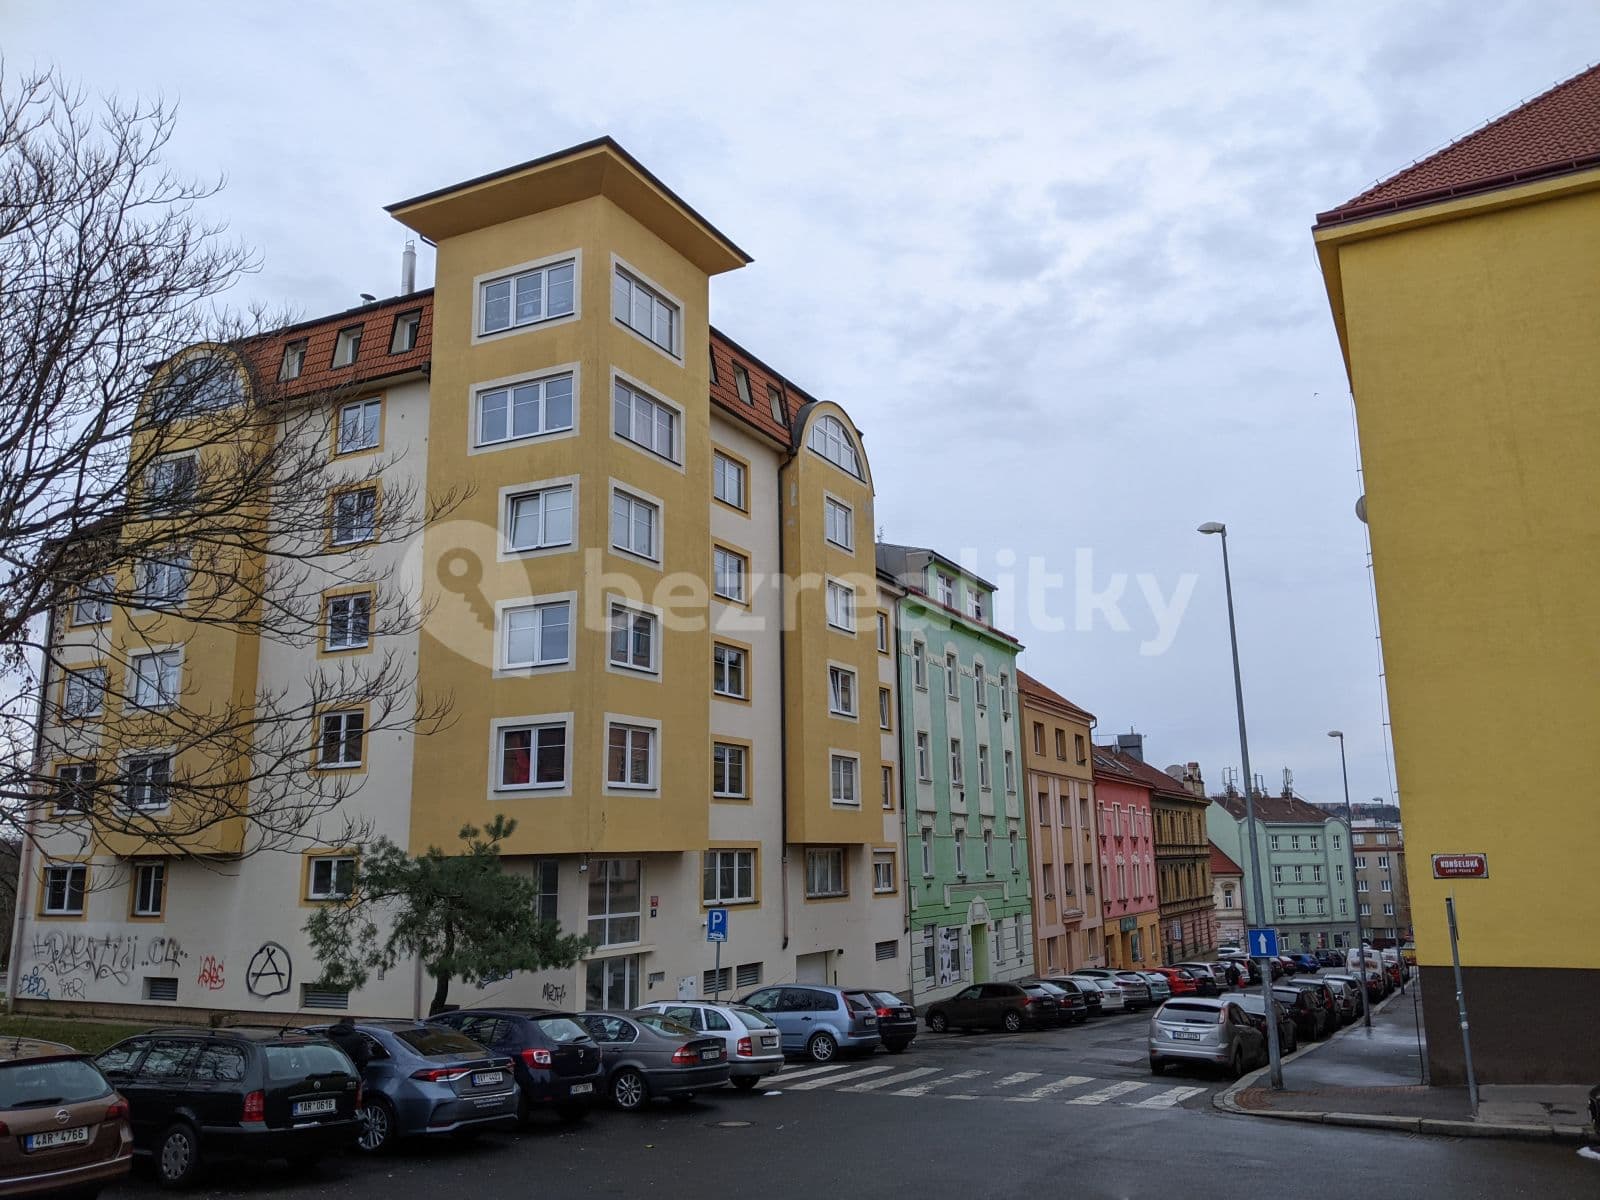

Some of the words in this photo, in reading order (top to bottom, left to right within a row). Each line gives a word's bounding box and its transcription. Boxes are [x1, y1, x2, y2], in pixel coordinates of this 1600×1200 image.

[712, 912, 722, 929] P
[35, 1132, 54, 1146] 4AR
[61, 1127, 84, 1142] 4766
